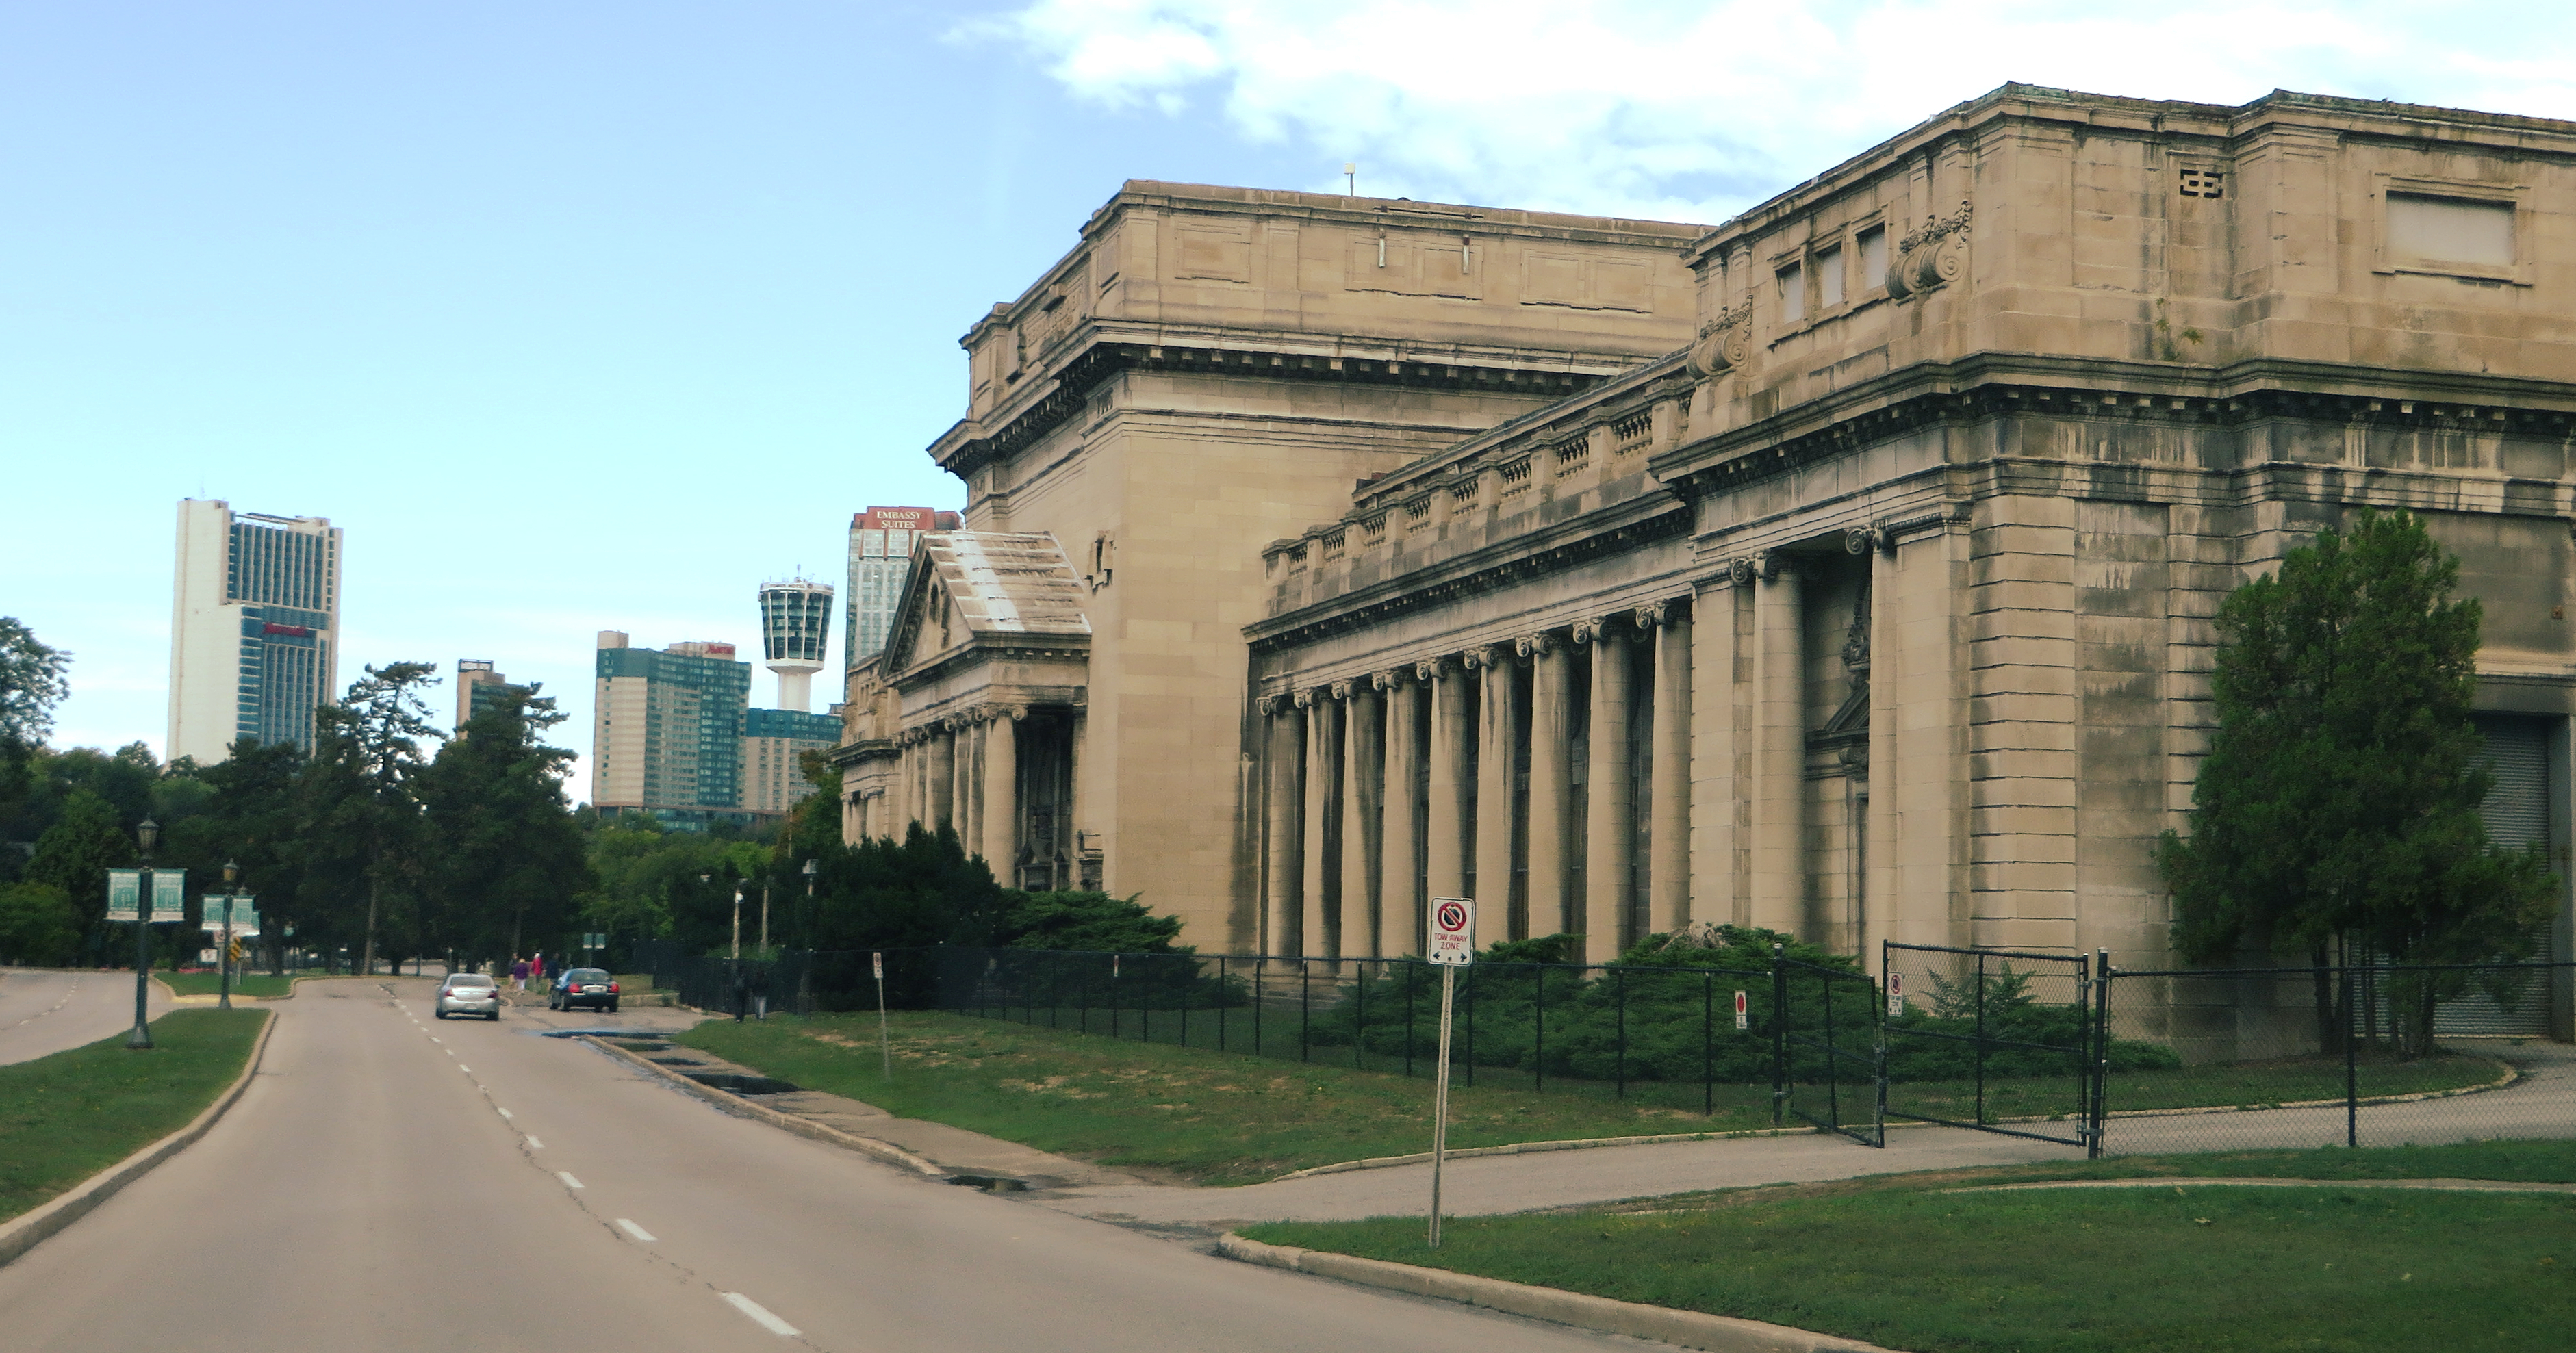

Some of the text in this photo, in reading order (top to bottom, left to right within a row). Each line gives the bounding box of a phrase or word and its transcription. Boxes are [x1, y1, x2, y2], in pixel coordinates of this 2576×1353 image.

[877, 511, 923, 519] EMBASSY
[882, 520, 915, 528] SUITES
[1440, 942, 1460, 950] ZONE
